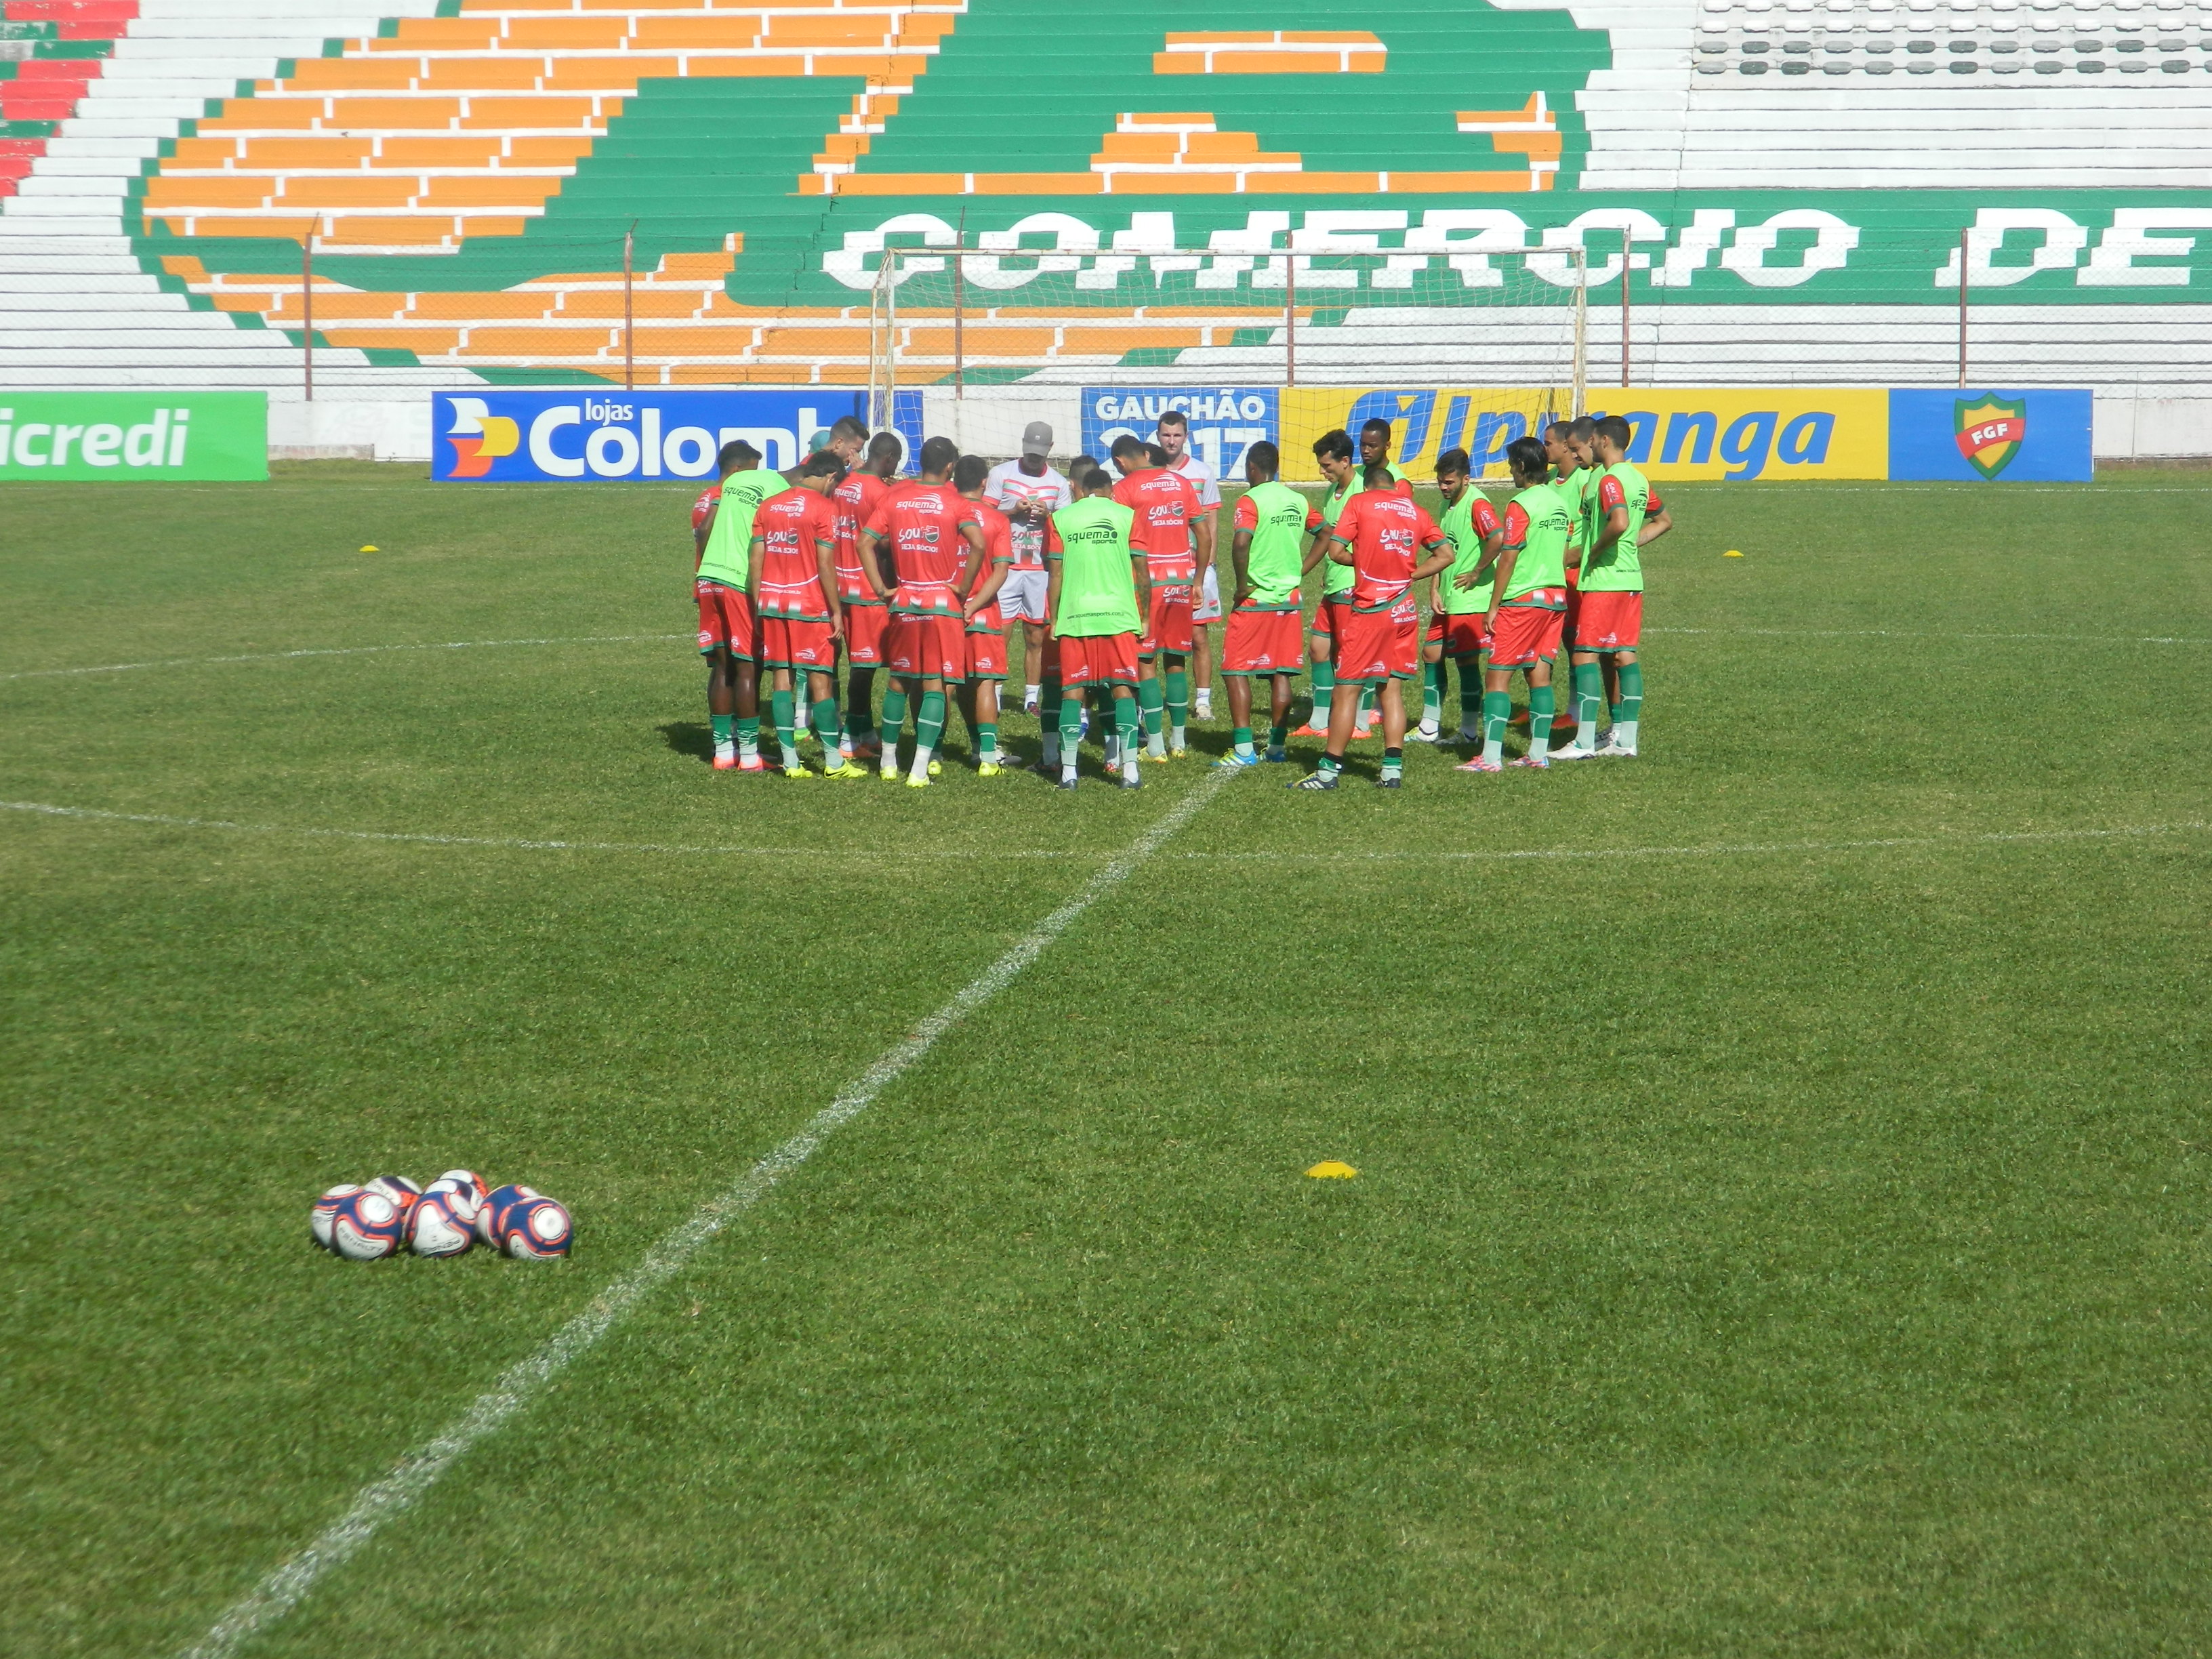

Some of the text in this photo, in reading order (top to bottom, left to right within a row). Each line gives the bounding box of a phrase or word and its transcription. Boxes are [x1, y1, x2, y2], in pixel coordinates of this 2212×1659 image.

[821, 207, 2212, 290] COMERCIO DE
[585, 398, 634, 426] lojas
[1095, 388, 1266, 422] GAUCHÃO
[1971, 422, 2009, 446] FGF
[1099, 426, 1267, 480] 217
[723, 486, 757, 502] squema
[896, 500, 936, 510] squema
[1067, 530, 1110, 544] squema
